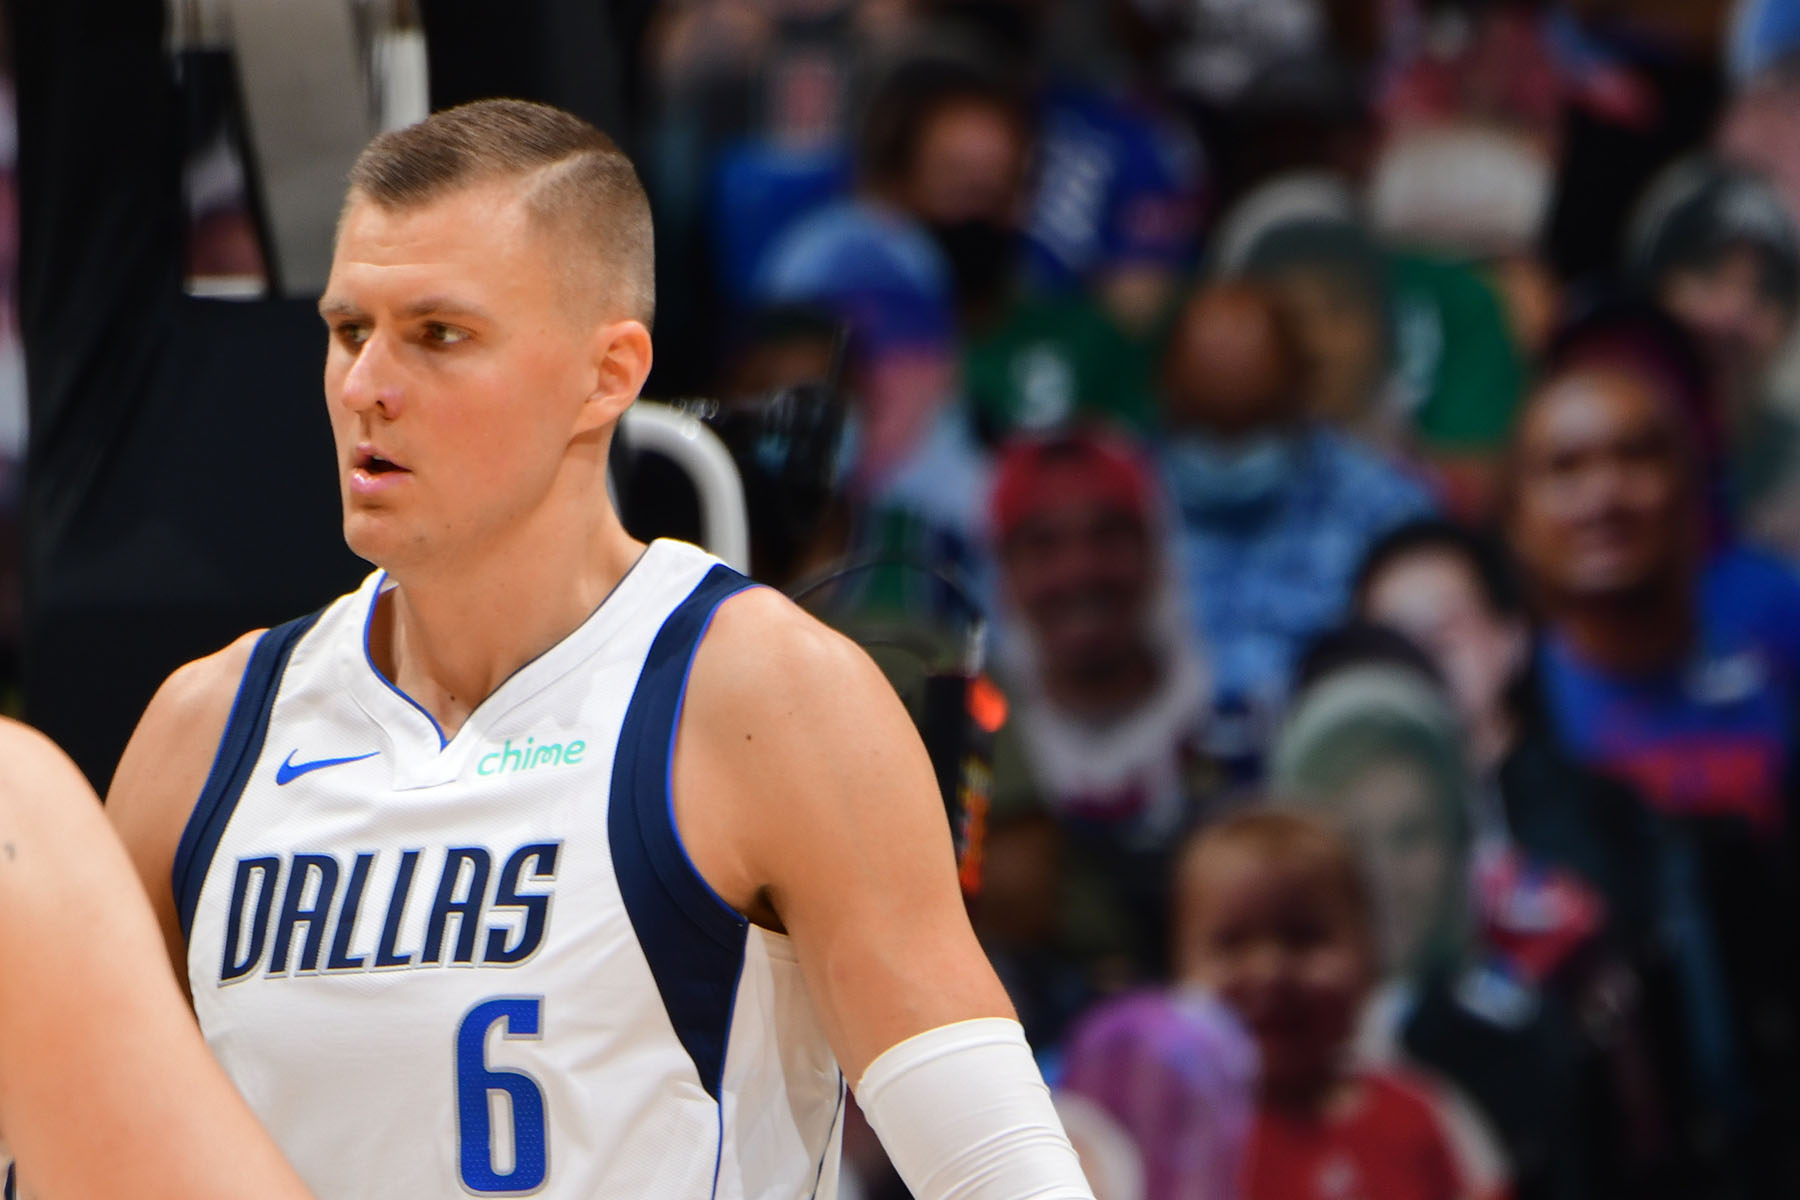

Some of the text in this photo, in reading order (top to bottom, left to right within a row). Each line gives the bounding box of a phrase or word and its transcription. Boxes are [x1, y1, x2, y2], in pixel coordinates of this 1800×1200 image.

[477, 737, 586, 776] chime
[217, 839, 564, 988] DALLAS
[453, 994, 551, 1198] 6
